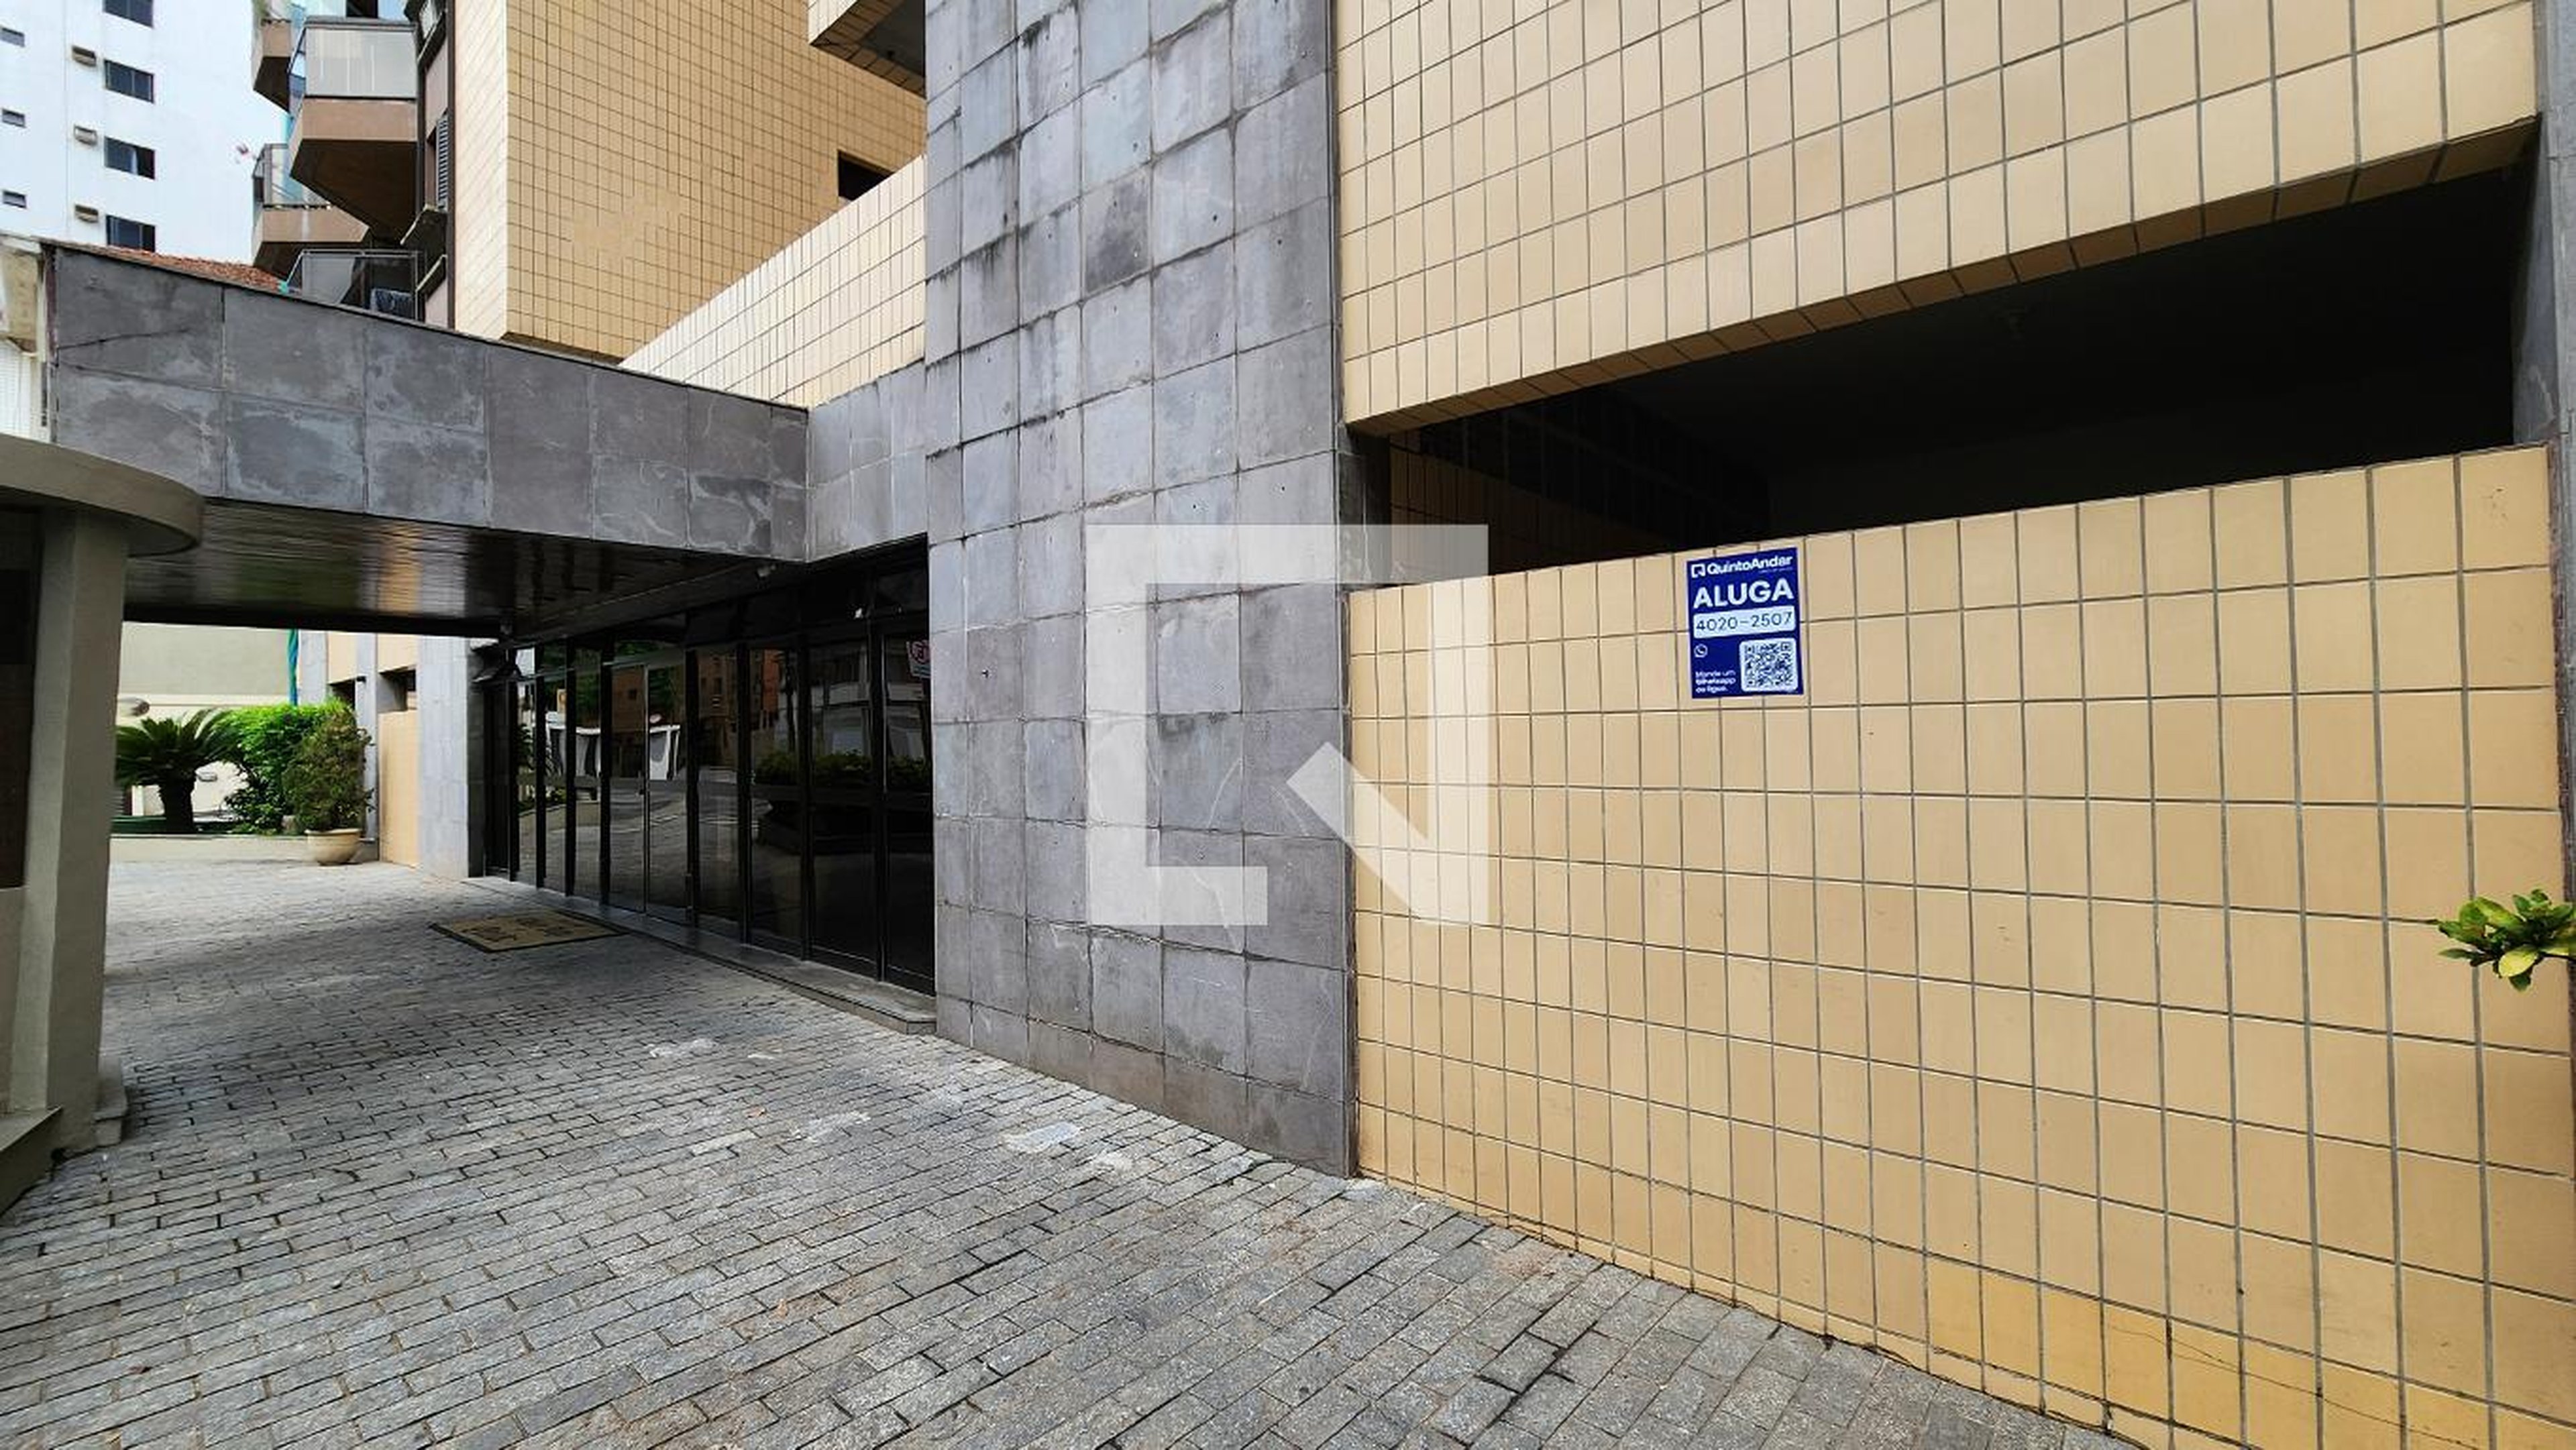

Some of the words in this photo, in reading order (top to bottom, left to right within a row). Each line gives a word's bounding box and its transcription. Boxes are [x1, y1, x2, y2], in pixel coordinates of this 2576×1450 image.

[1707, 555, 1793, 575] QuintoAndar
[1693, 577, 1794, 608] ALUGA
[1696, 611, 1792, 631] 4020-2507
